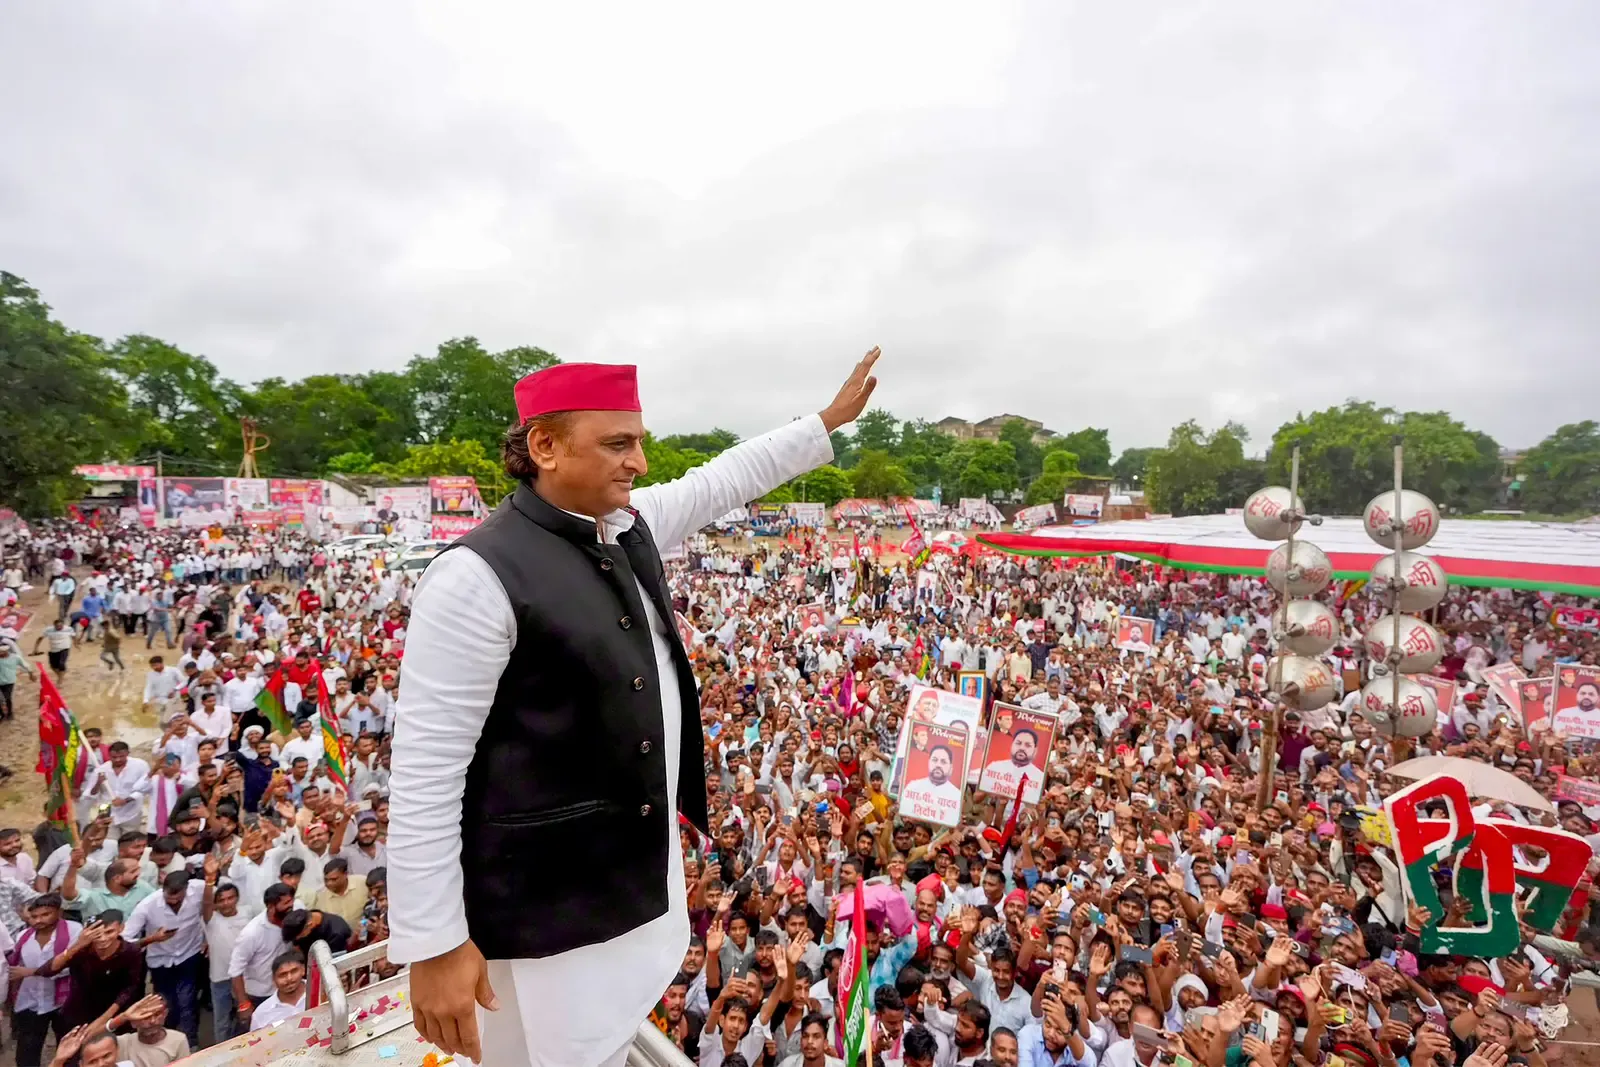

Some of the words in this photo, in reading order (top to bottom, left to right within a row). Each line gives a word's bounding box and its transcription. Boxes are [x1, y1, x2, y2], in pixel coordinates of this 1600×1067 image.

[1408, 560, 1437, 587] रफी
[1402, 625, 1436, 658] रफी
[1401, 695, 1426, 717] रफी
[937, 796, 958, 810] यादव
